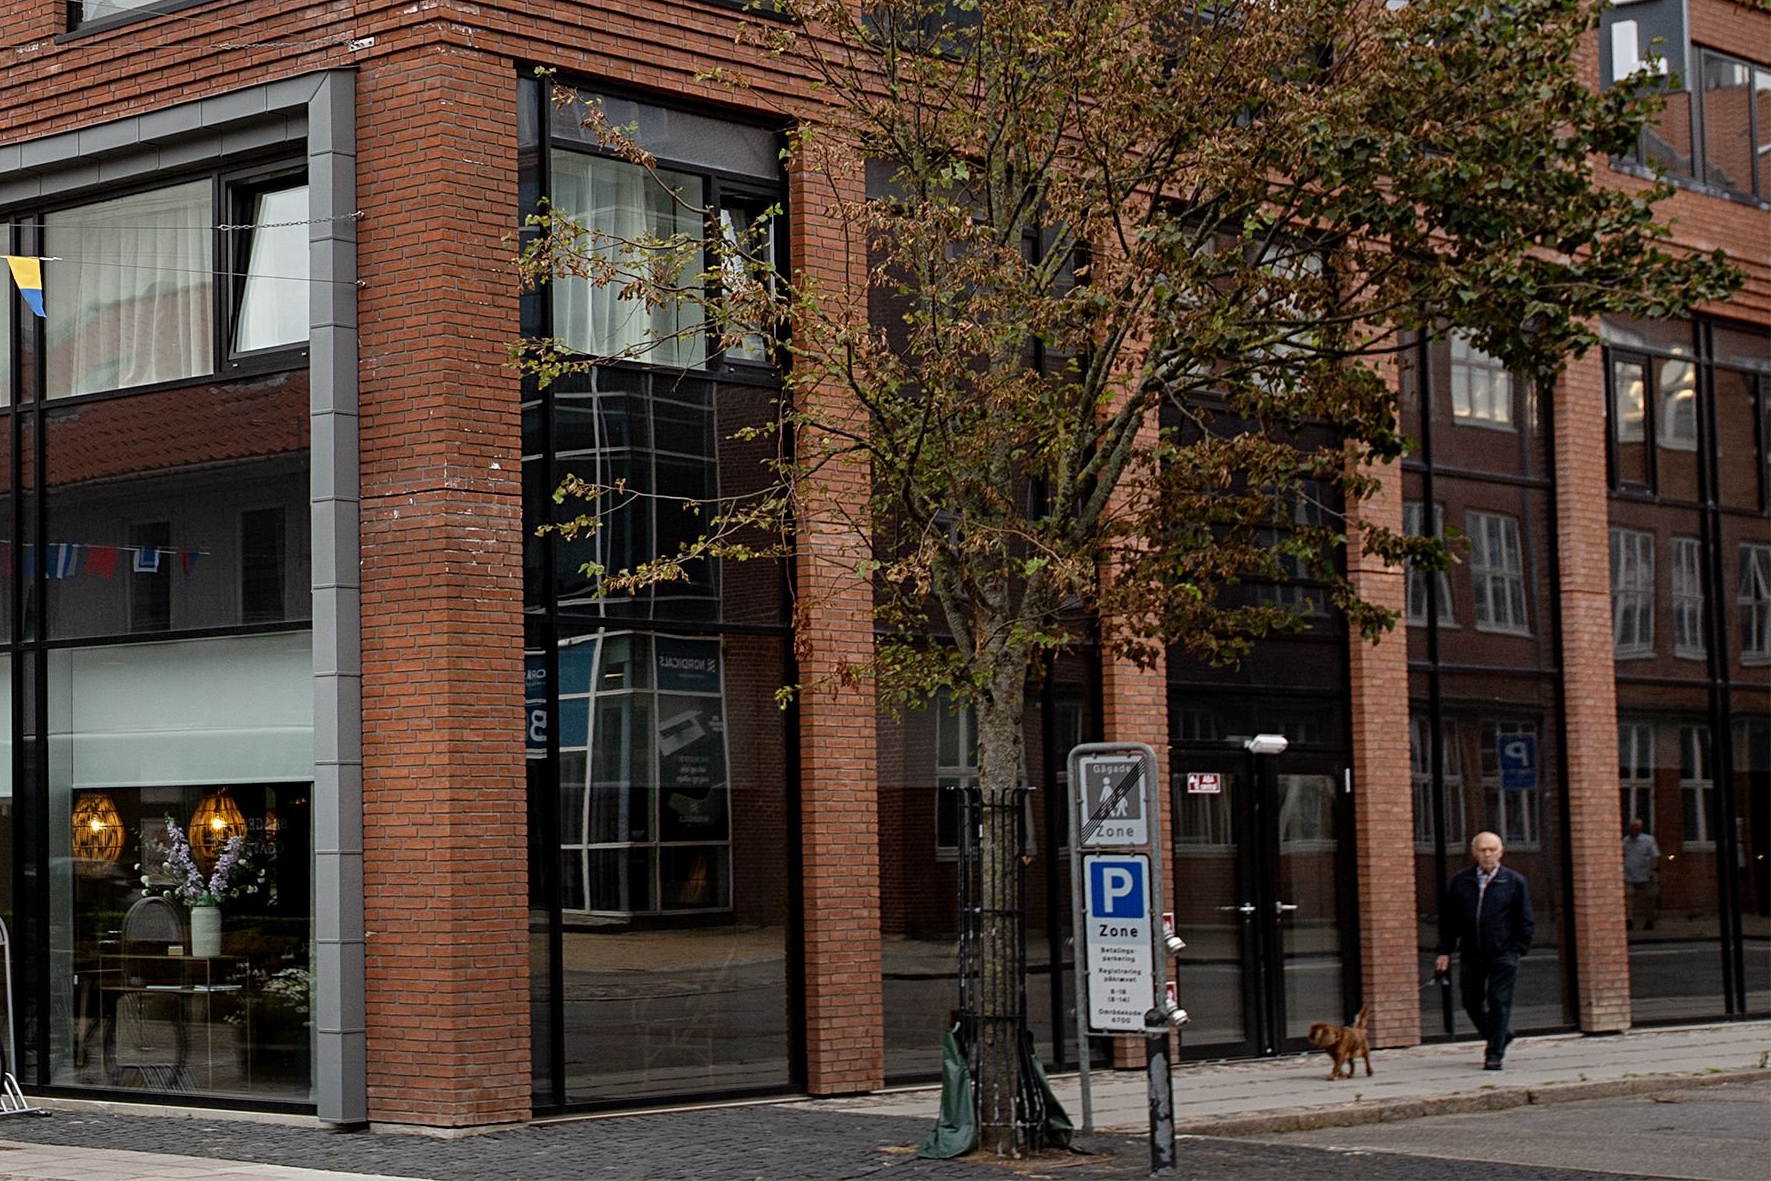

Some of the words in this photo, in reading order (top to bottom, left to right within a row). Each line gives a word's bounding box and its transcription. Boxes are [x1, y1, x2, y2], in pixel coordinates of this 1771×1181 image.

[1096, 825, 1134, 837] Zone
[1102, 867, 1133, 913] P
[1099, 924, 1138, 938] Zone
